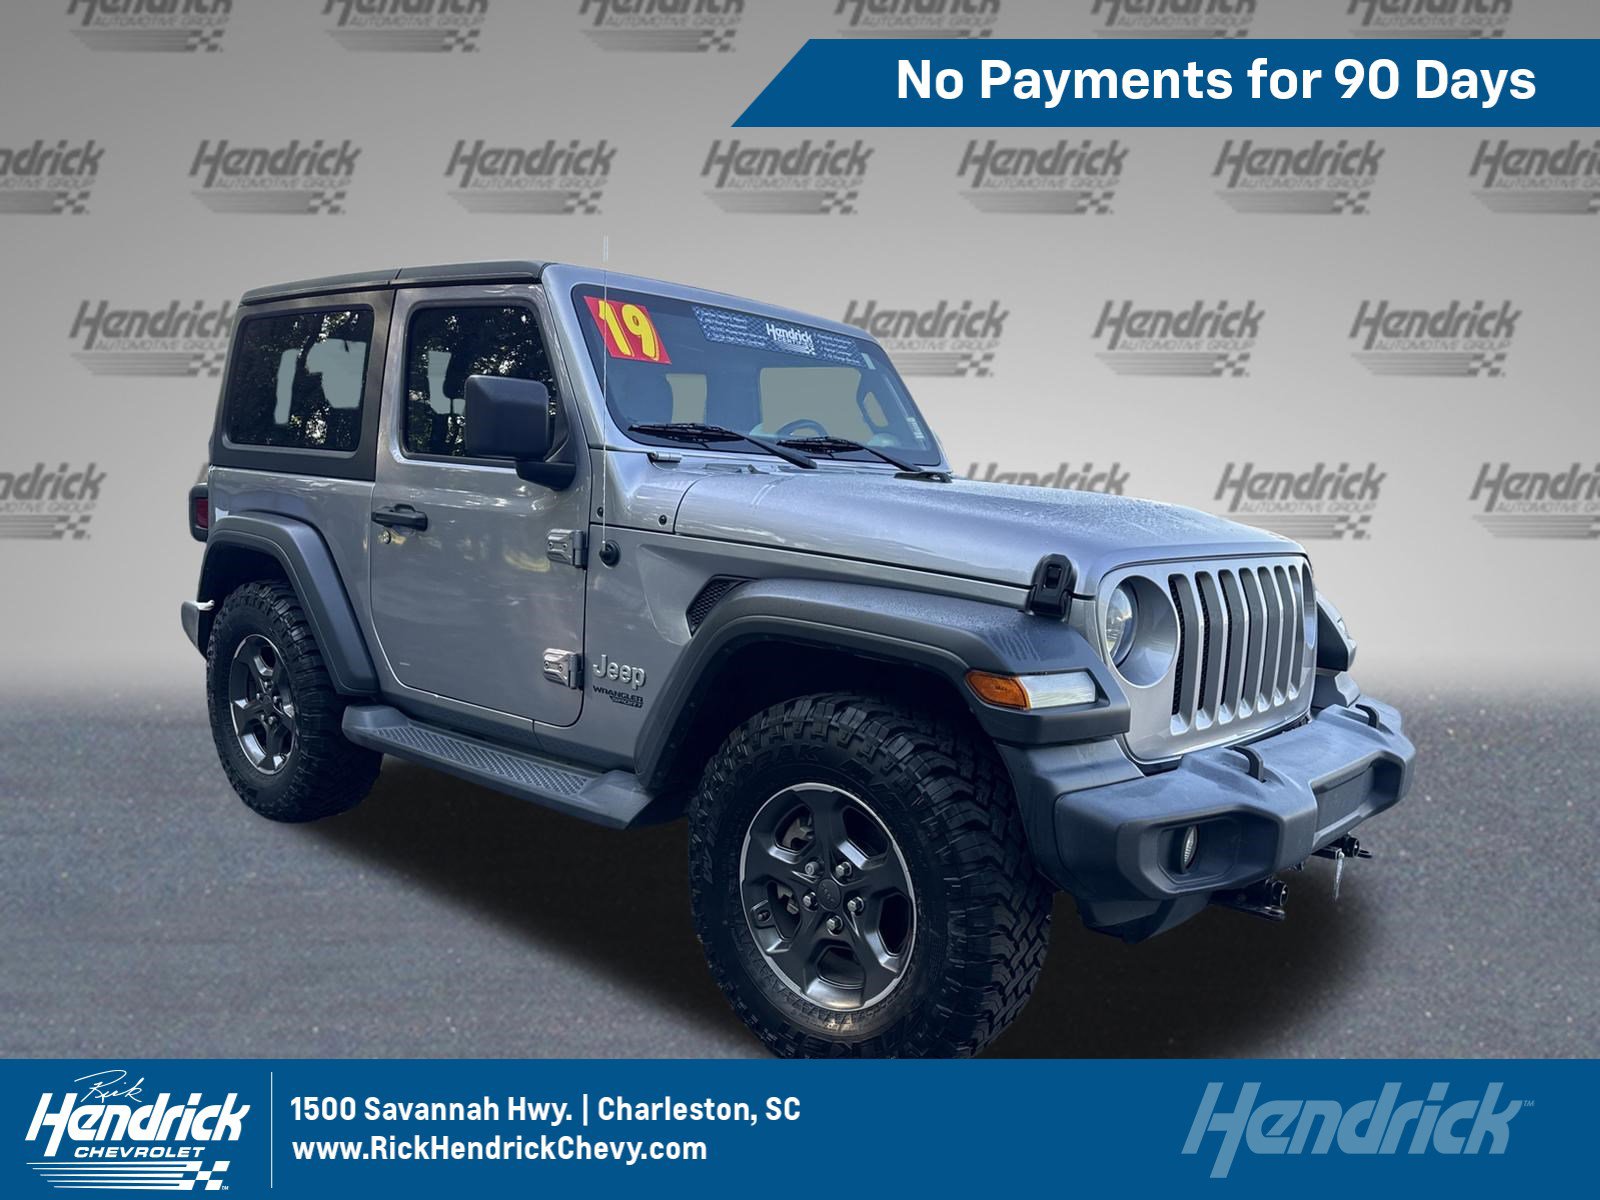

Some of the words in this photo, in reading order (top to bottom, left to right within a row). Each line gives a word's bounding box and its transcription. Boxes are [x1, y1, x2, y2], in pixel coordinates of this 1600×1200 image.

[189, 139, 361, 188] Hendrick
[445, 139, 617, 188] Hendrick
[702, 139, 874, 188] Hendrick
[957, 139, 1129, 188] Hendrick
[1213, 139, 1385, 188] Hendrick
[1468, 139, 1600, 188] Hendri
[598, 300, 660, 361] 19
[765, 323, 813, 344] Hendrick
[1091, 299, 1265, 350] Hendrick
[1349, 299, 1522, 350] Hendrick
[1213, 462, 1387, 512] Hendrick
[1469, 462, 1600, 512] Hendri
[592, 654, 646, 691] Jeep
